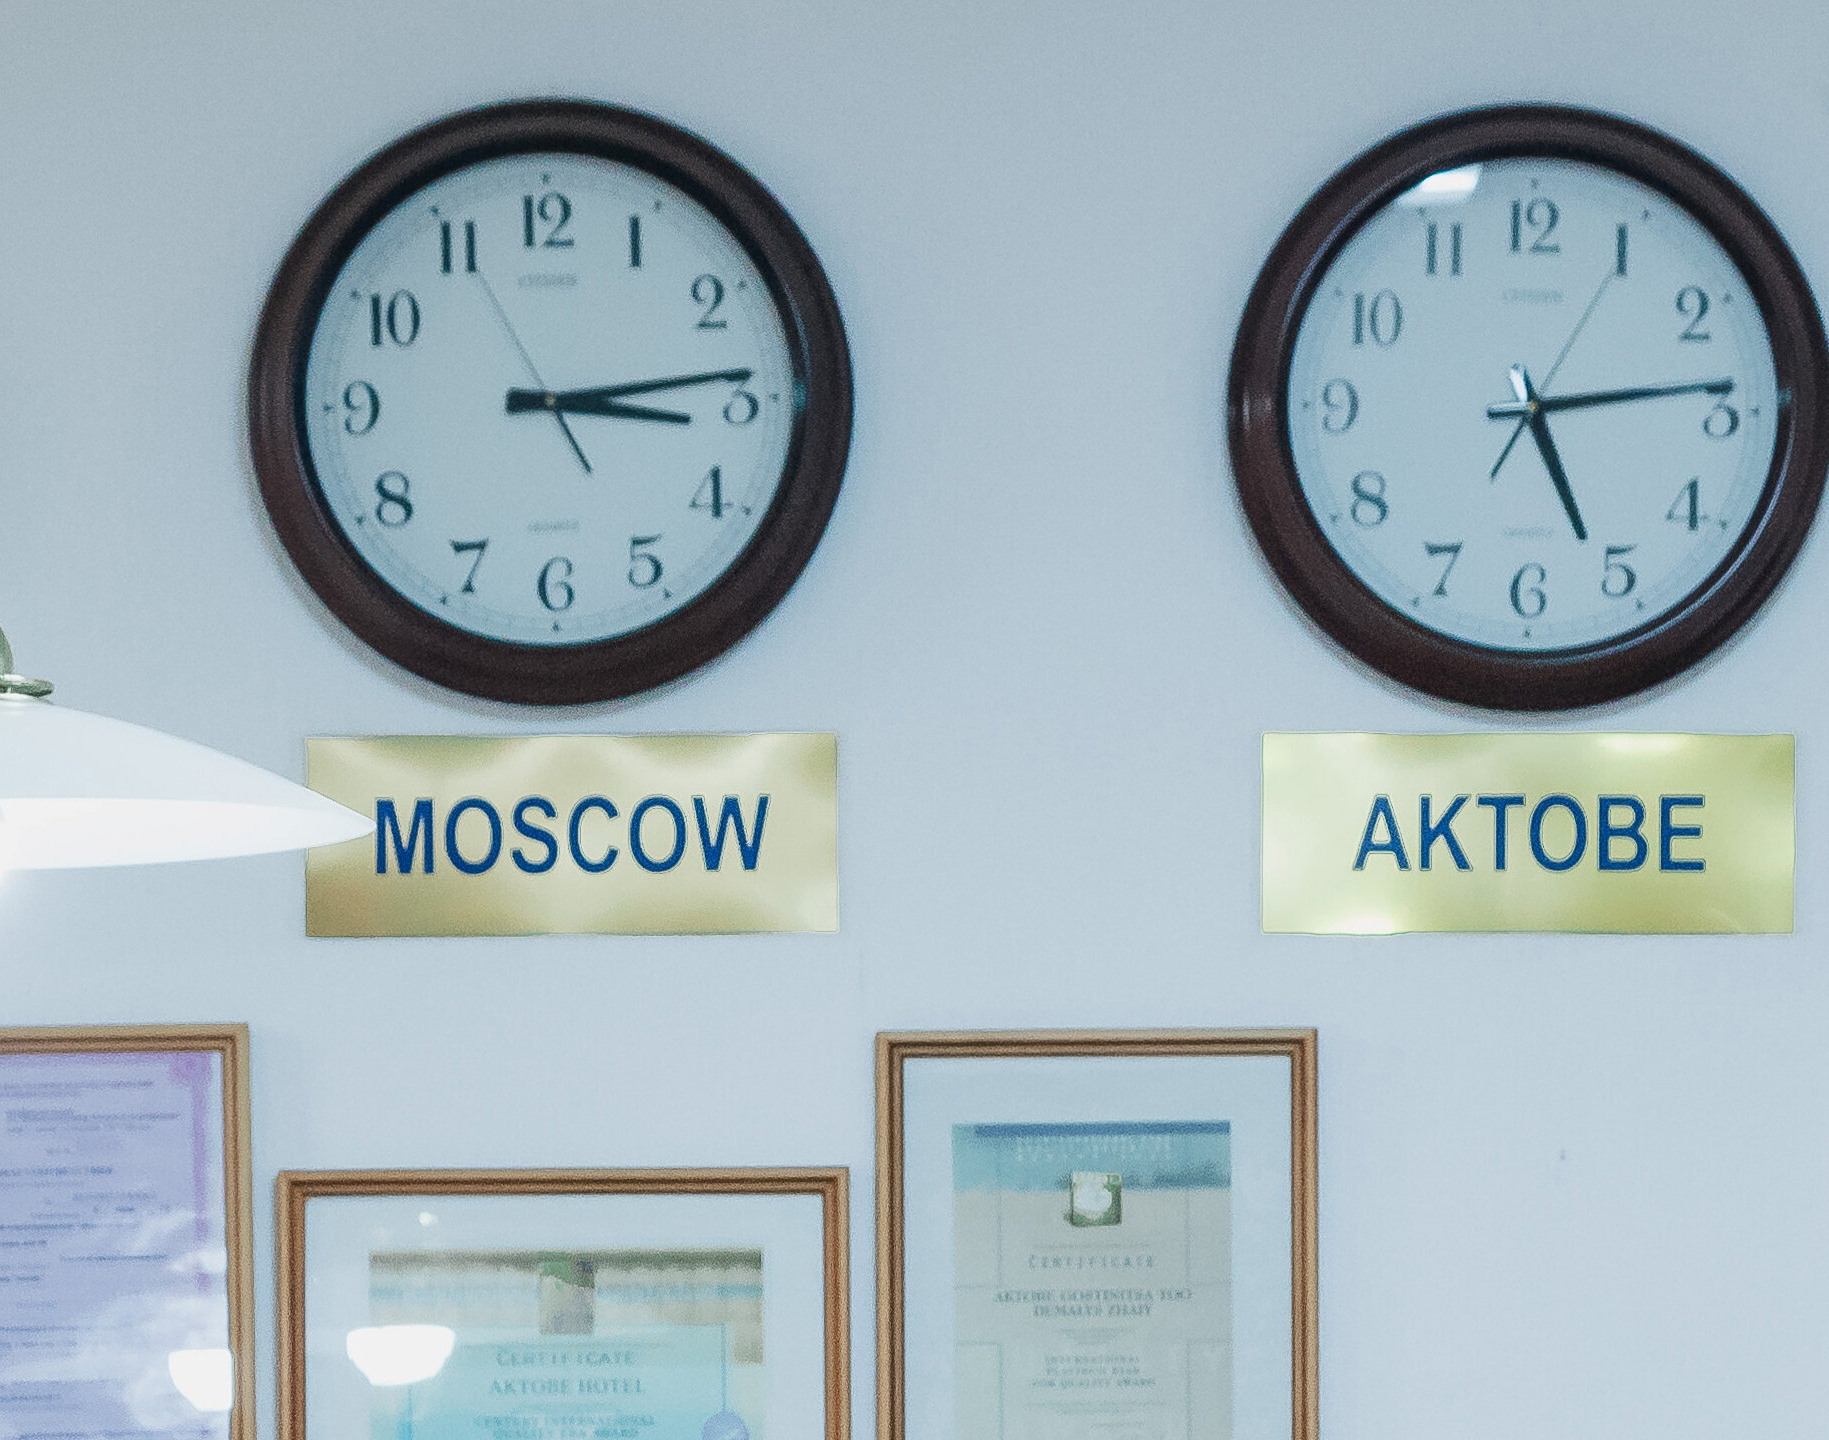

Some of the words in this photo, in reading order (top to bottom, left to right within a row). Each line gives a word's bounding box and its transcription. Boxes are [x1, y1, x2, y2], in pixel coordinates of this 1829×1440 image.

[522, 191, 575, 248] 12
[628, 214, 642, 268] 1
[1510, 198, 1560, 254] 12
[440, 220, 478, 275] 11
[1426, 221, 1462, 276] 11
[1614, 222, 1628, 277] 1
[370, 289, 421, 347] 10
[690, 274, 727, 329] 2
[1352, 289, 1403, 346] 10
[1675, 286, 1711, 341] 2
[342, 380, 381, 436] 9
[722, 375, 759, 427] 3
[1321, 378, 1359, 434] 9
[1701, 389, 1739, 439] 3
[374, 471, 414, 527] 8
[689, 465, 733, 519] 4
[1350, 472, 1388, 527] 8
[1666, 477, 1709, 531] 4
[450, 539, 489, 594] 7
[537, 557, 575, 612] 6
[628, 535, 663, 589] 5
[1425, 543, 1462, 596] 7
[1601, 545, 1636, 597] 5
[1510, 564, 1547, 618] 6
[375, 794, 770, 876] MOSCOW
[1353, 794, 1707, 873] AKTOBE
